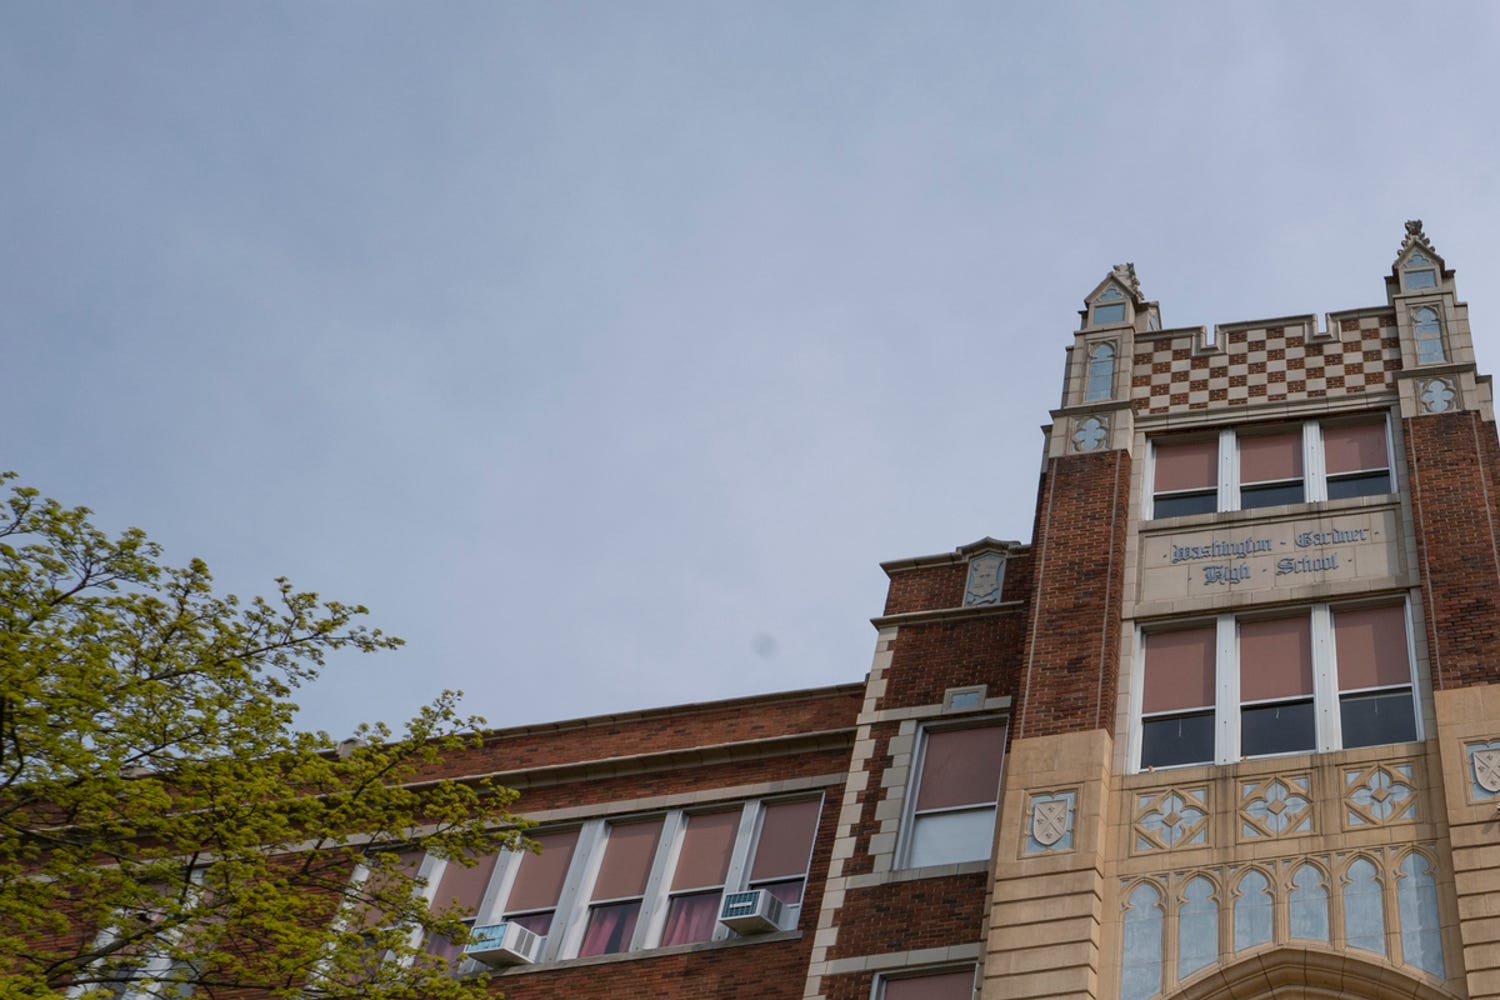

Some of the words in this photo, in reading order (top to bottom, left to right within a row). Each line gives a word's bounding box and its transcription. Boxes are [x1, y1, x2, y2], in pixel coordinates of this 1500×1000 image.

[1172, 537, 1273, 564] Washington
[1295, 528, 1369, 548] Gardner
[1203, 562, 1251, 585] High
[1276, 552, 1339, 576] School
